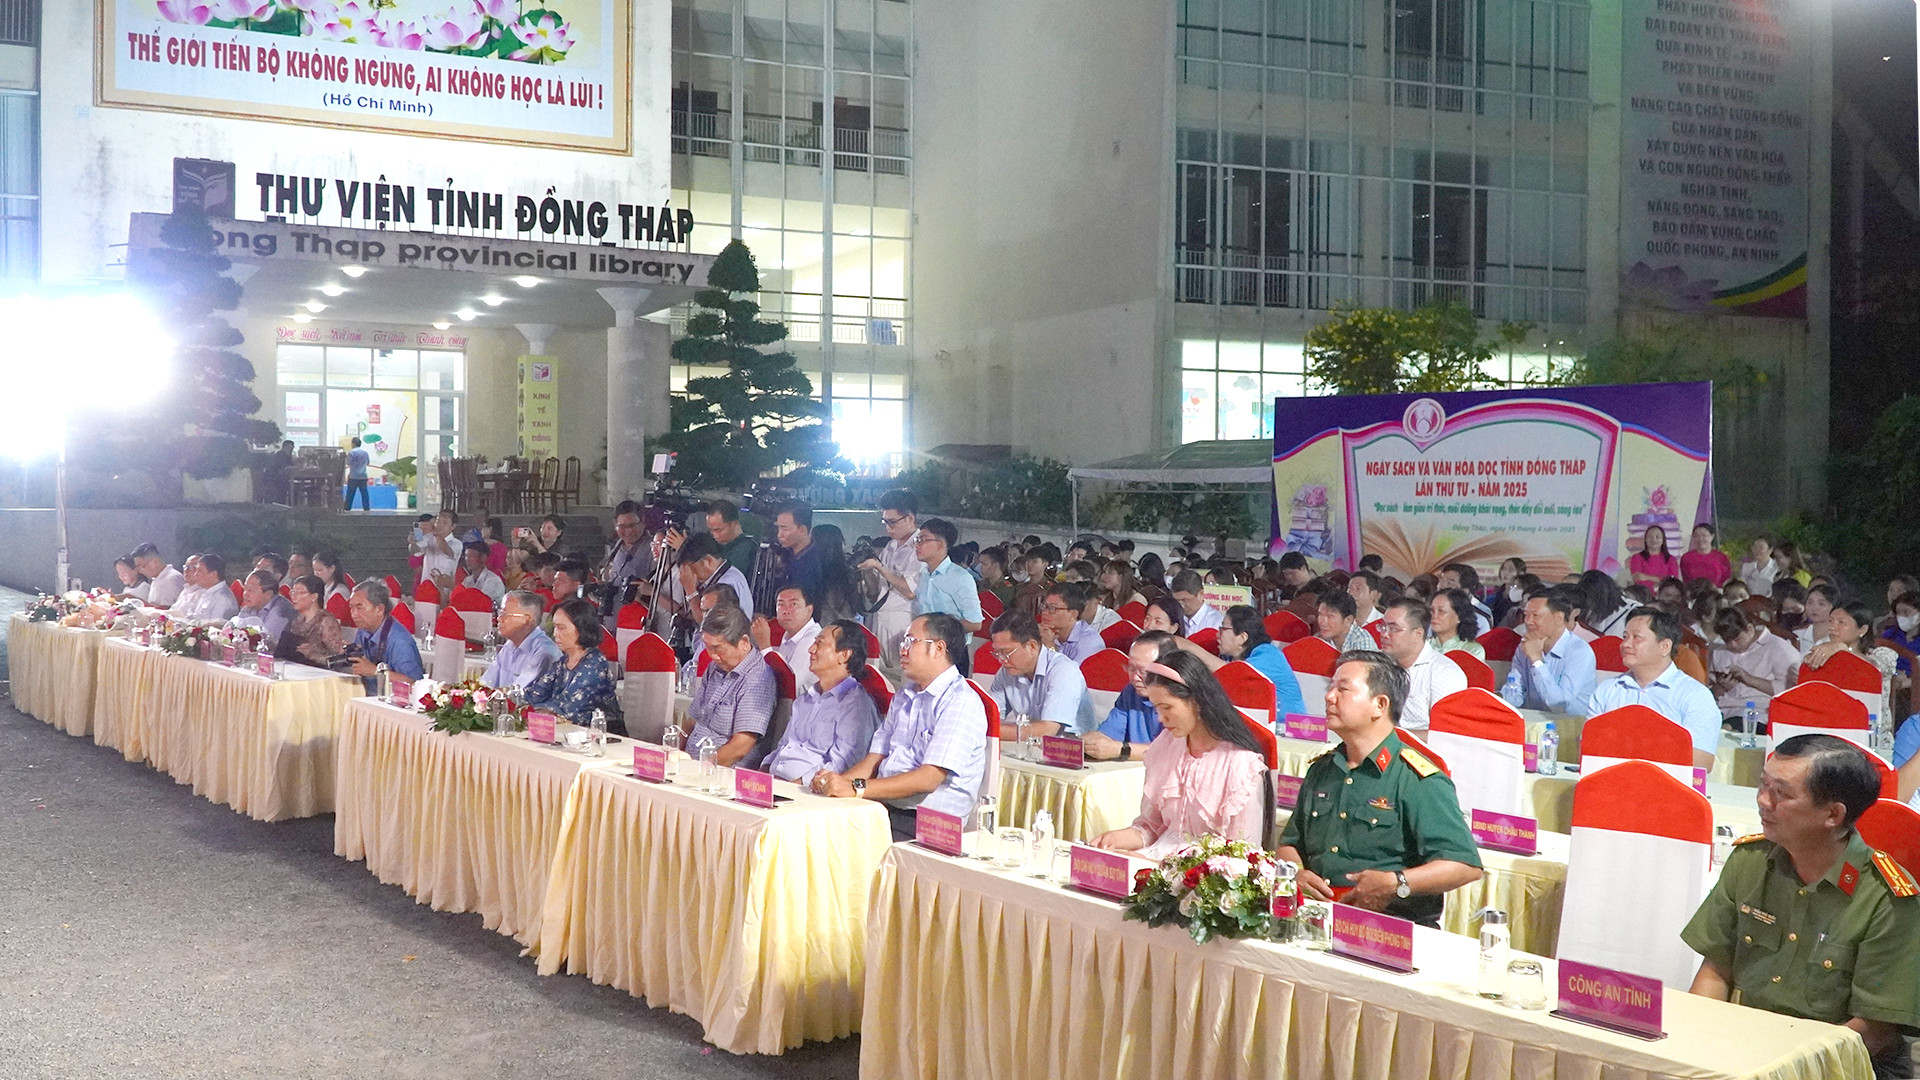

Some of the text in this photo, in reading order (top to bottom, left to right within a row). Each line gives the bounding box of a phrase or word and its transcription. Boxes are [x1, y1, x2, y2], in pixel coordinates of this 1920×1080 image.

[127, 23, 161, 62] THẾ
[165, 34, 207, 67] GIỚI
[212, 35, 251, 73] TIẾN
[256, 42, 281, 83] BỘ
[286, 46, 349, 82] KHÔNG
[355, 51, 421, 95] NGỪNG,
[424, 66, 443, 91] AI
[447, 63, 506, 96] KHÔNG
[510, 75, 543, 109] HỌC
[546, 70, 566, 104] LÀ
[570, 77, 594, 108] LÙI
[322, 91, 435, 116] (Hồ Chí Minh)
[255, 171, 695, 242] THƯ VIỆN TỈNH ĐỒNG THÁP
[210, 227, 695, 282] ong Thap provincial library
[1366, 459, 1391, 476] NGÀY
[1393, 459, 1415, 476] SÁCH
[1419, 459, 1430, 475] VÀ
[1455, 458, 1474, 475] HÓA
[1478, 461, 1497, 478] ĐỌC
[1501, 458, 1523, 475] TỈNH
[1527, 457, 1557, 475] ĐỒNG
[1560, 458, 1587, 475] THÁP
[1504, 482, 1527, 497] 2025
[1568, 974, 1651, 1009] CÔNG AN TỈNH
